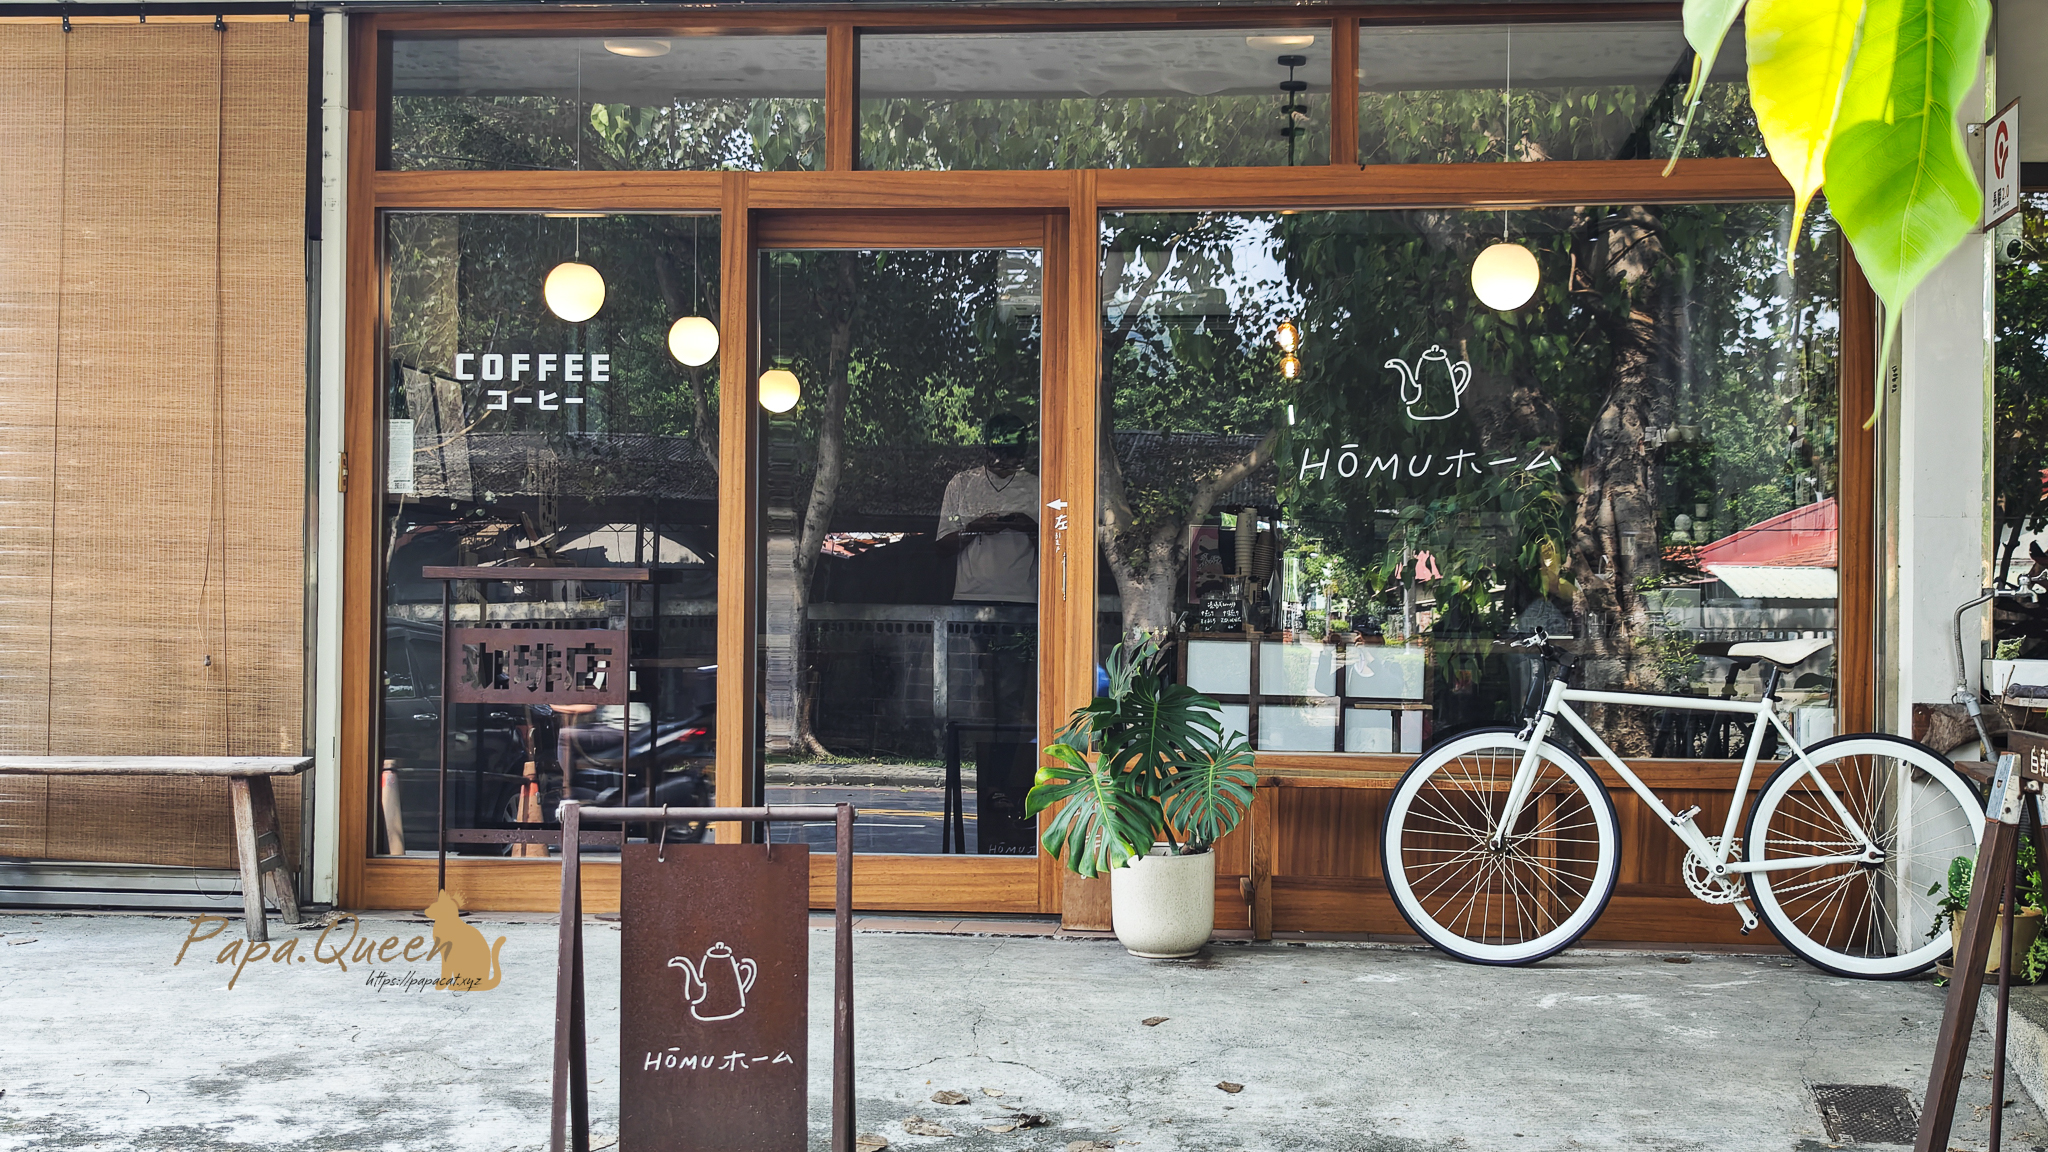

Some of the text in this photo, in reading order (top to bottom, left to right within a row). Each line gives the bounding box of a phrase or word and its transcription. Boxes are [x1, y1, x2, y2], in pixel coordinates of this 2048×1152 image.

[456, 353, 610, 382] COFFEE
[487, 390, 584, 412] コーヒー
[462, 642, 613, 692] 珈琲店
